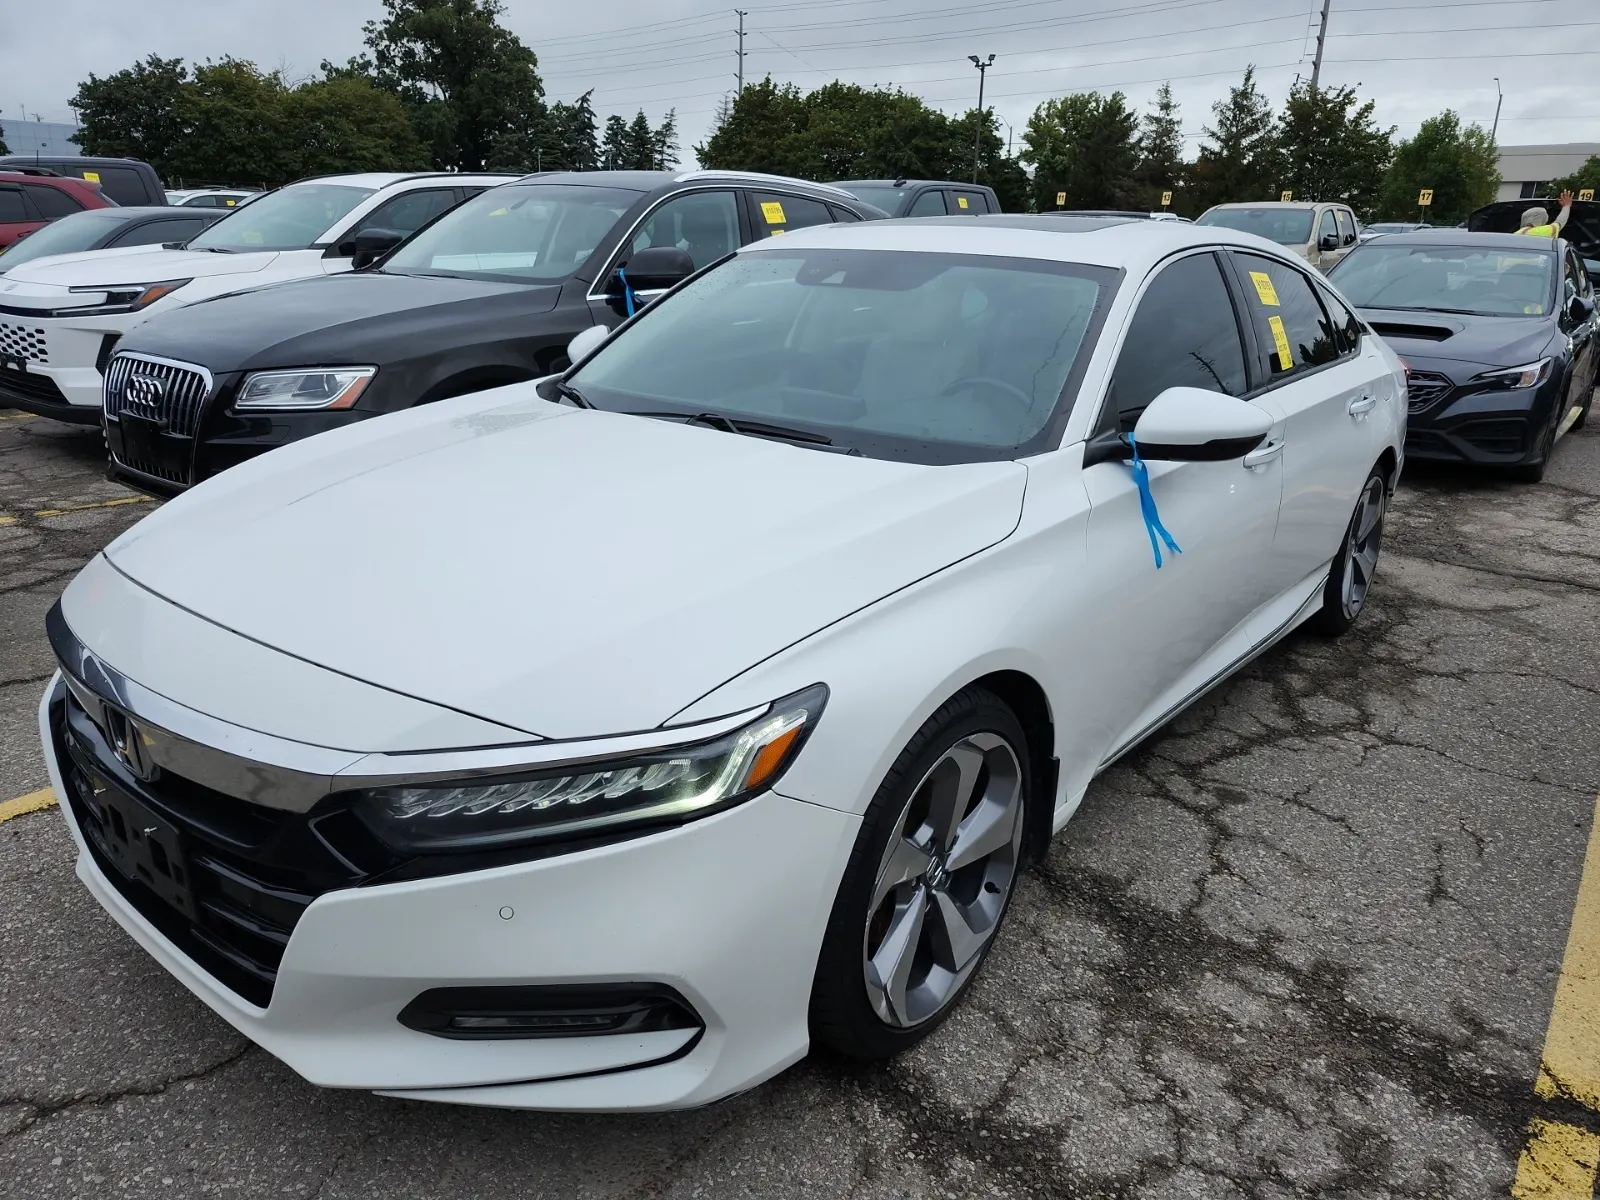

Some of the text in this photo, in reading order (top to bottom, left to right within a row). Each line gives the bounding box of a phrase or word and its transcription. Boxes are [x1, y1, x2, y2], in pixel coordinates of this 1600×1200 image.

[1058, 194, 1065, 202] 11
[1421, 192, 1431, 201] 17
[1580, 192, 1592, 200] 19
